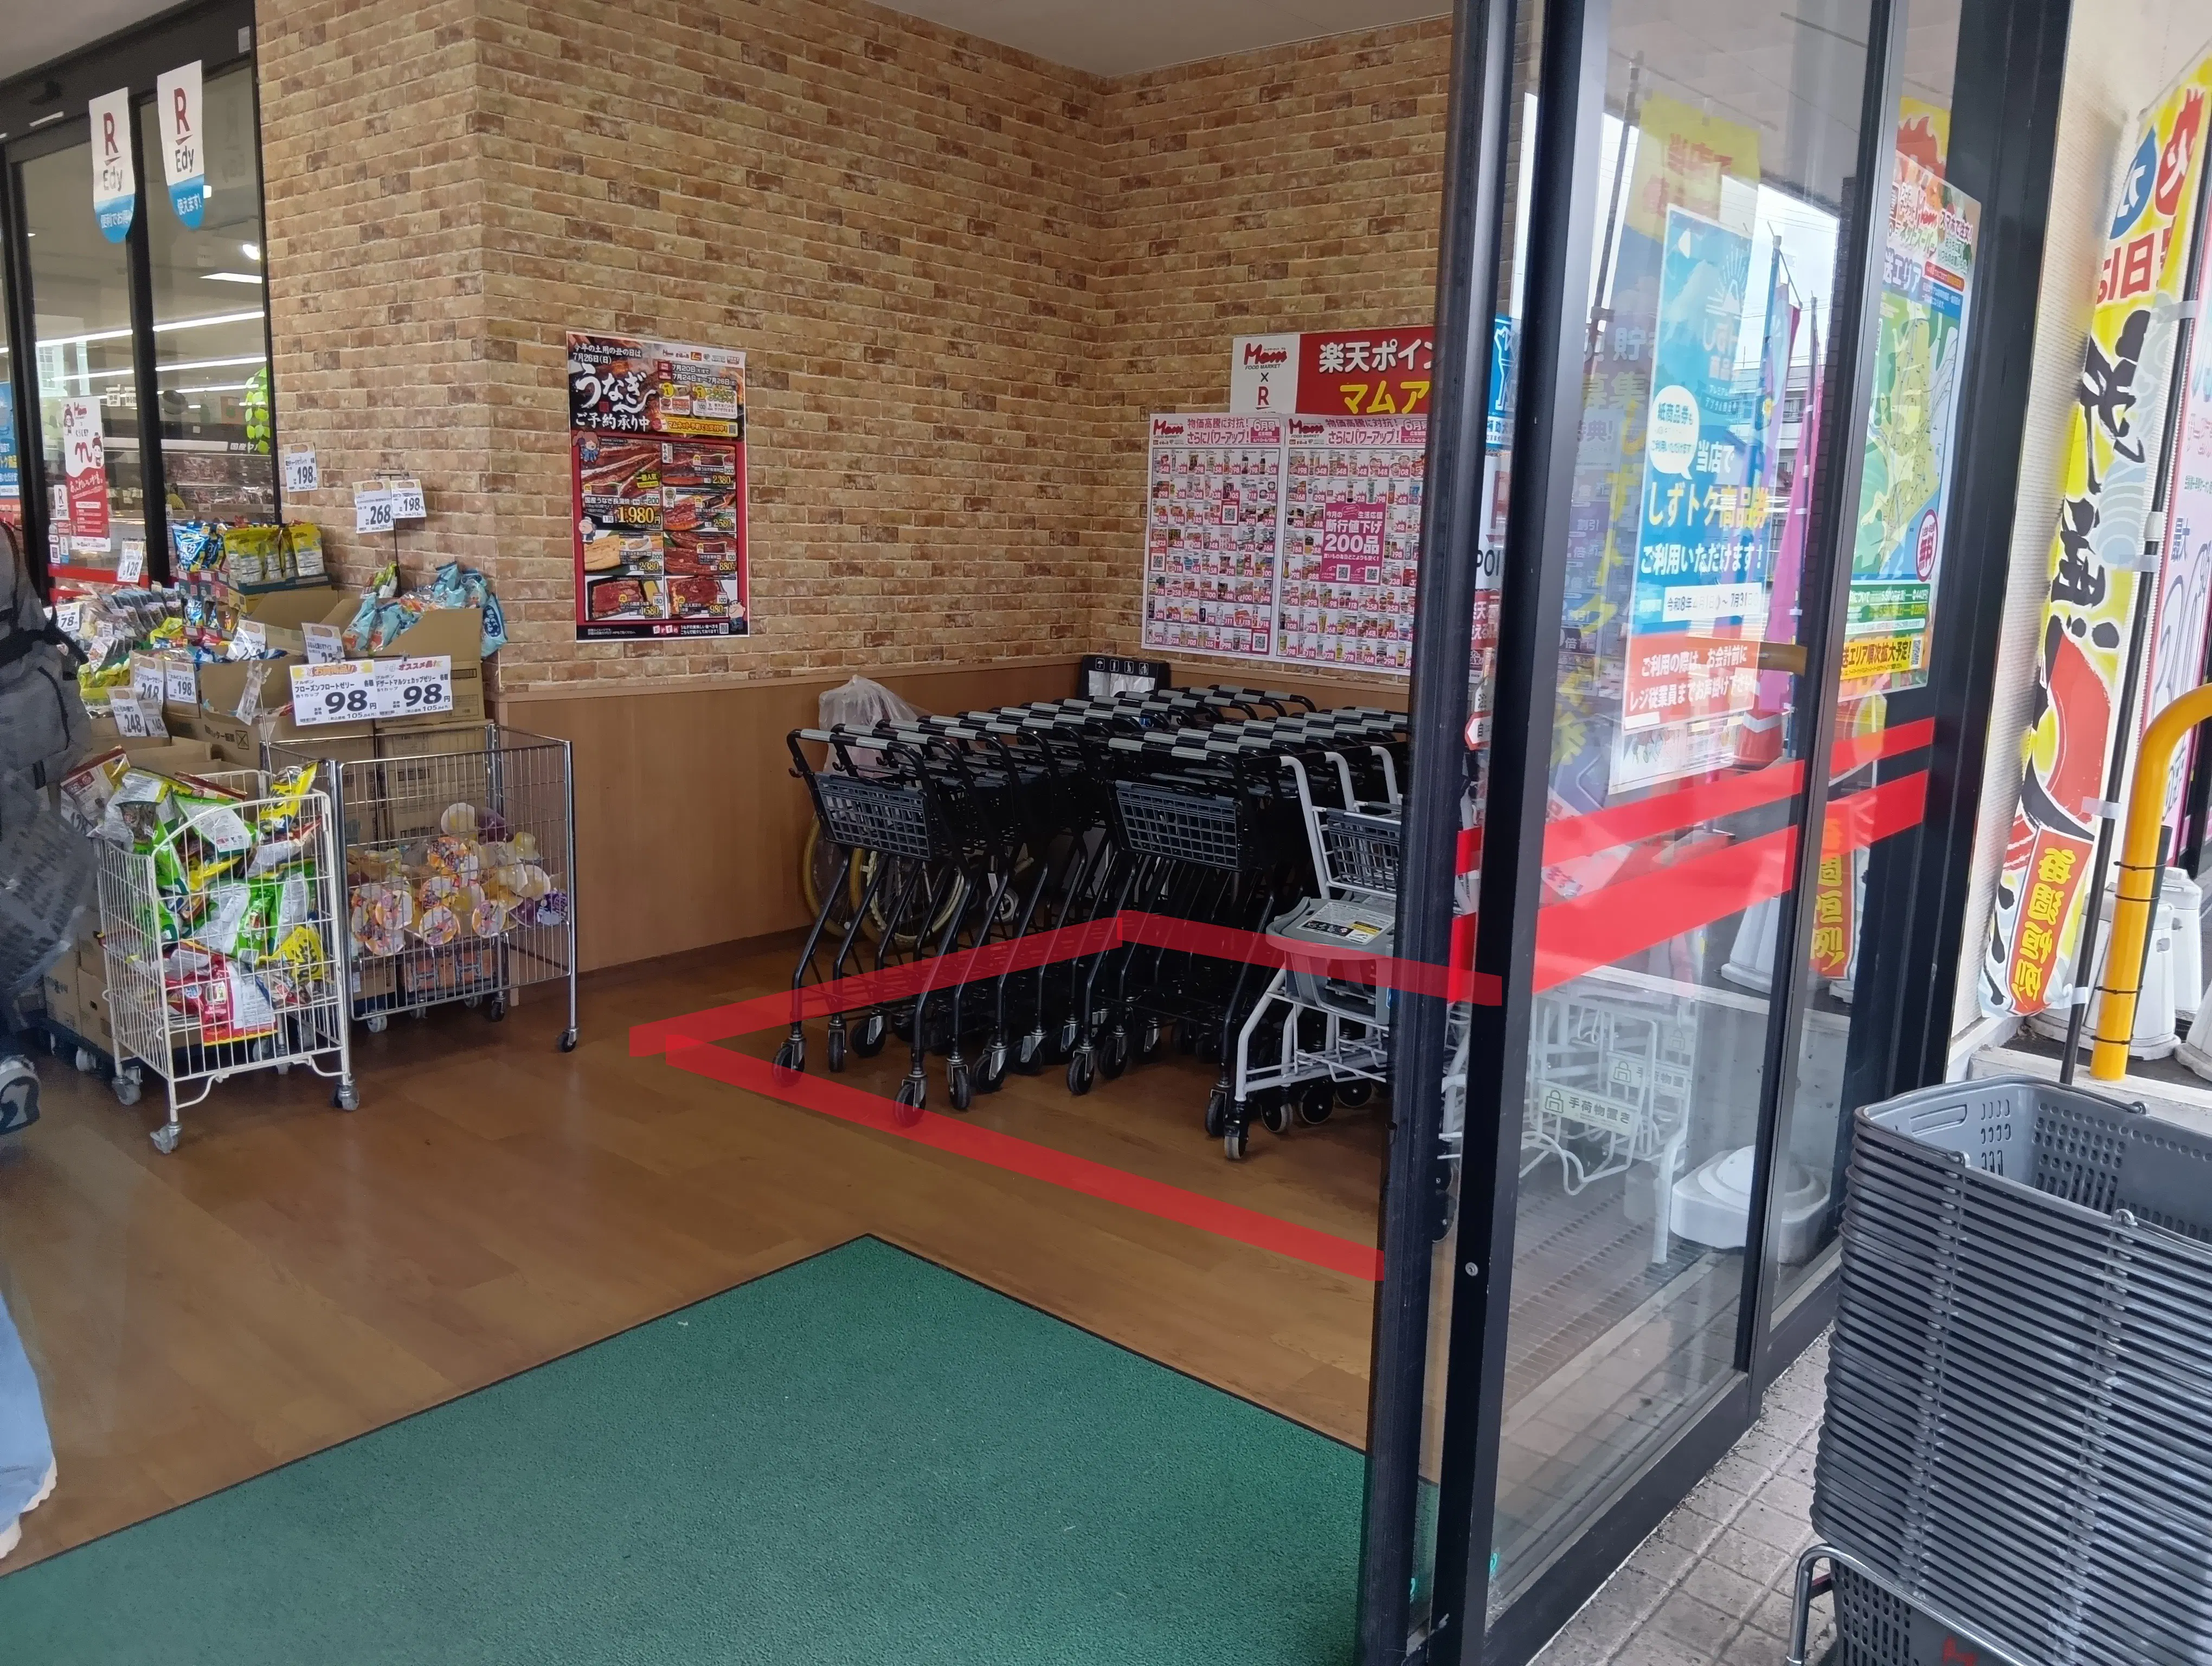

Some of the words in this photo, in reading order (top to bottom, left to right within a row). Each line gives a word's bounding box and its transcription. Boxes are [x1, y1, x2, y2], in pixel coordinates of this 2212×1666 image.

[174, 88, 190, 134] R
[104, 112, 119, 156] R
[175, 145, 194, 172] Edy
[103, 166, 123, 191] Edy
[1244, 343, 1288, 365] Mom
[576, 362, 648, 411] うなぎ
[1257, 386, 1270, 405] R
[1340, 380, 1430, 414] マムア
[576, 413, 650, 432] ご予約承り中
[1153, 419, 1184, 435] Mom
[1253, 419, 1276, 432] 6月号
[1289, 418, 1324, 434] Mom
[1187, 430, 1249, 444] さらにパワーアップ!
[1328, 428, 1400, 445] さらにパワーアップ!
[1696, 440, 1735, 474] 当店で
[297, 465, 313, 484] 198
[403, 497, 420, 511] 198
[370, 504, 391, 525] 268
[1325, 520, 1382, 534] 断行値下げ
[1324, 534, 1380, 554] 200品
[1641, 542, 1763, 575] ご利用いただけます!
[177, 681, 192, 696] 198
[295, 682, 355, 693] フローズンフロートゼリー
[403, 683, 442, 707] 98
[325, 690, 368, 714] 98
[124, 714, 142, 733] 248
[1568, 1095, 1631, 1124] 手荷物置き
